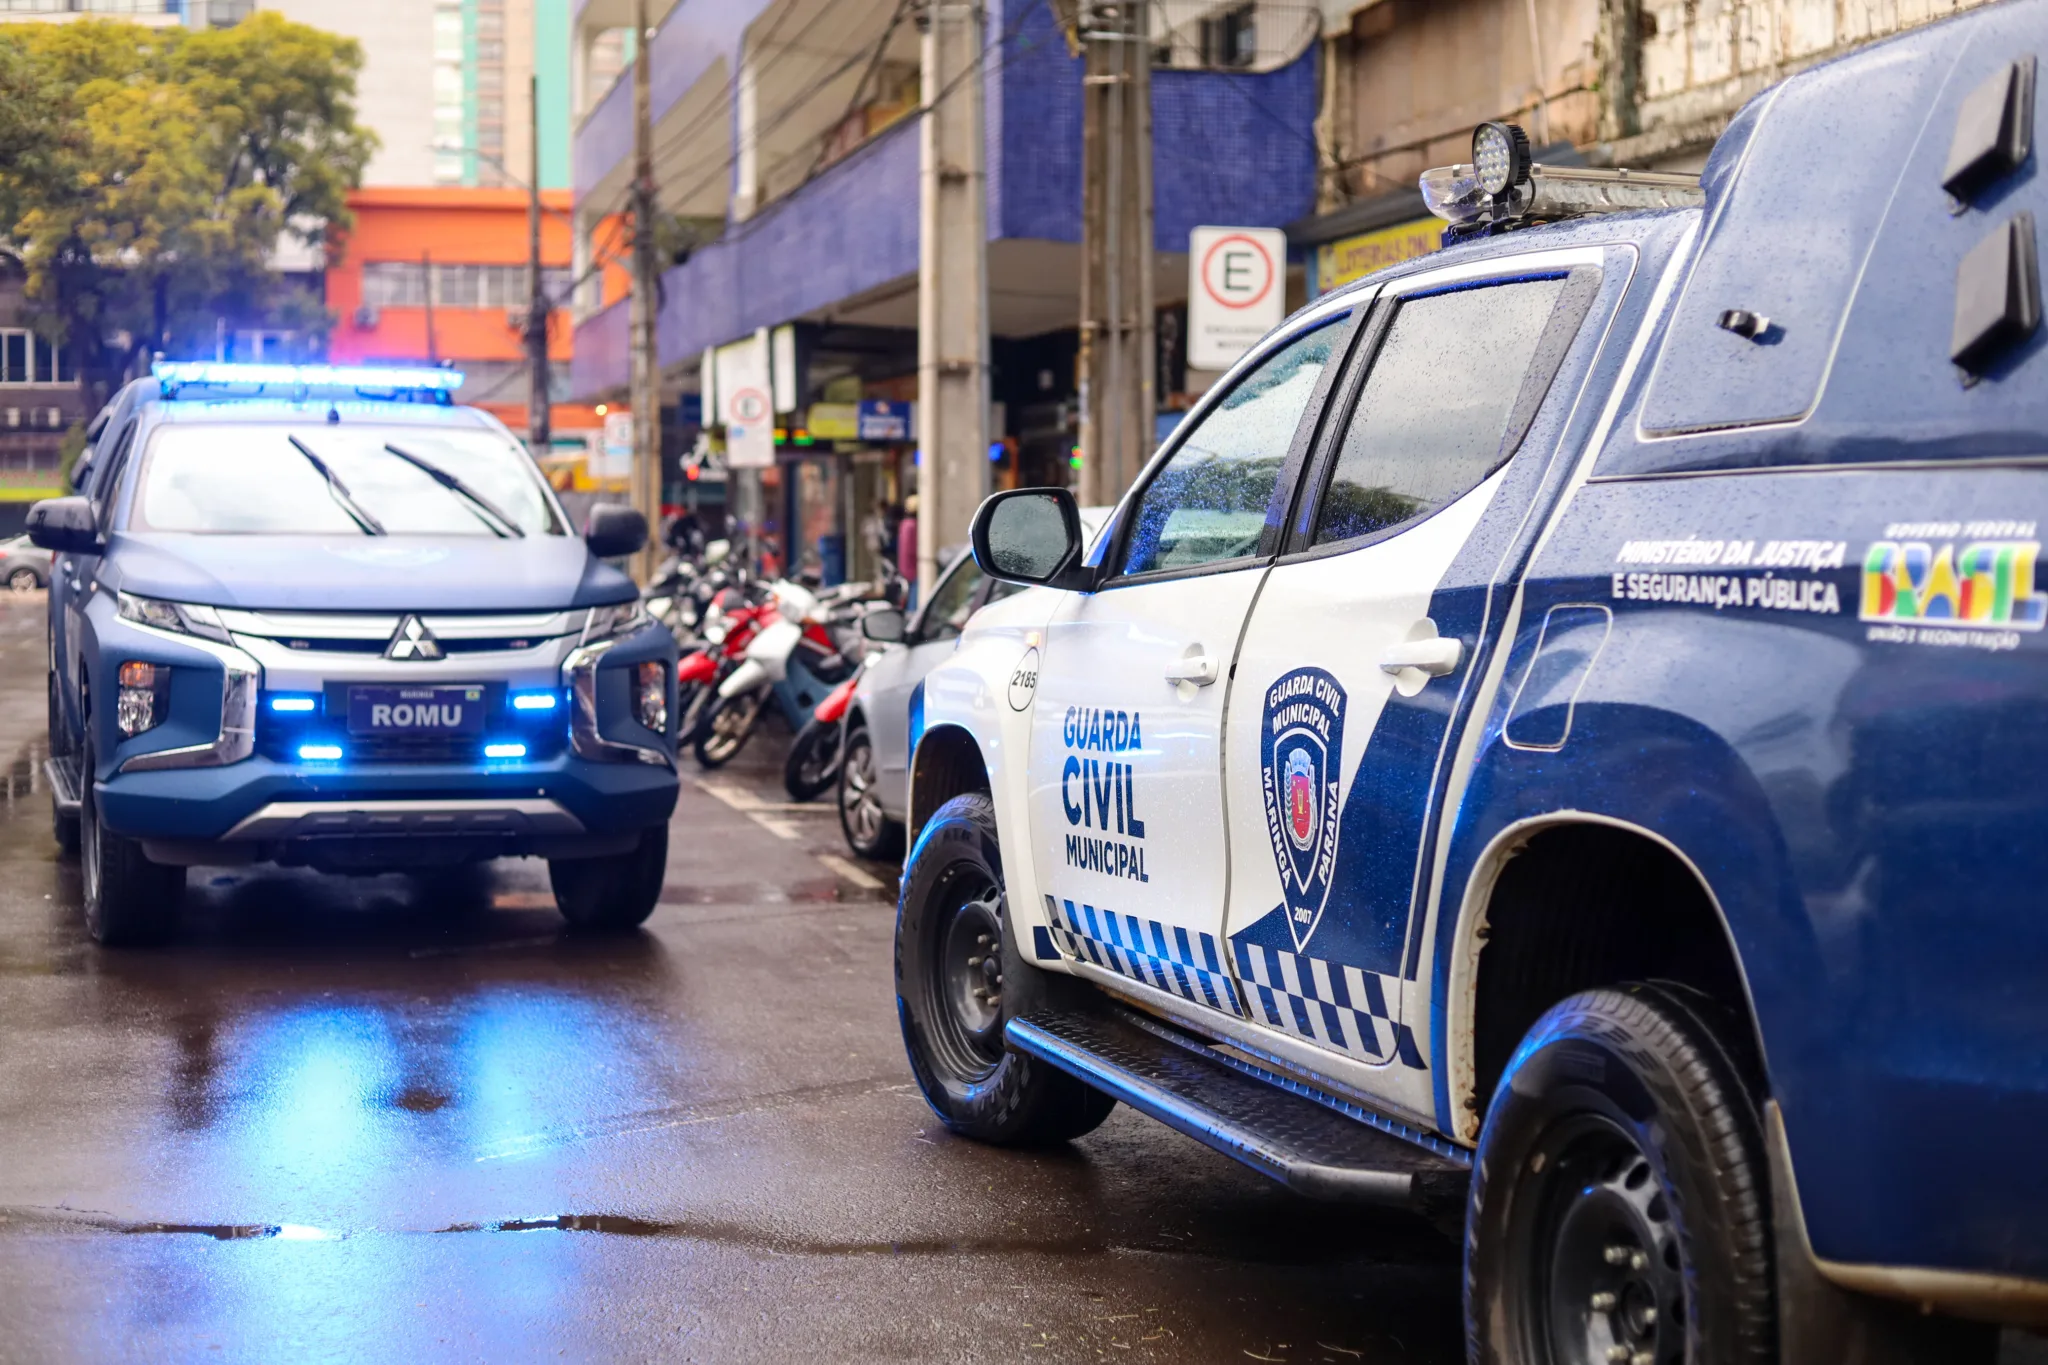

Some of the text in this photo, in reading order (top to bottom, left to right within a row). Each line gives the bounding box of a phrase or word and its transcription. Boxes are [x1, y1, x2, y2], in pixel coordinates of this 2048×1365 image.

[1224, 252, 1254, 291] E
[1616, 535, 1847, 572] MINISTÉRIO DA JUSTIÇA
[1612, 571, 1840, 613] E SEGURANÇA PÚBLICA
[1859, 541, 2048, 631] BRASIL
[1012, 670, 1036, 689] 2185
[1270, 675, 1340, 717] GUARDA CIVIL
[371, 704, 462, 727] ROMU
[1064, 706, 1141, 752] GUARDA
[1273, 703, 1330, 742] MUNICIPAL
[1062, 755, 1145, 839] CIVIL
[1263, 767, 1292, 889] MARINGÁ
[1318, 781, 1338, 886] PARANÁ
[1066, 834, 1149, 883] MUNICIPAL
[1294, 907, 1312, 924] 2007
